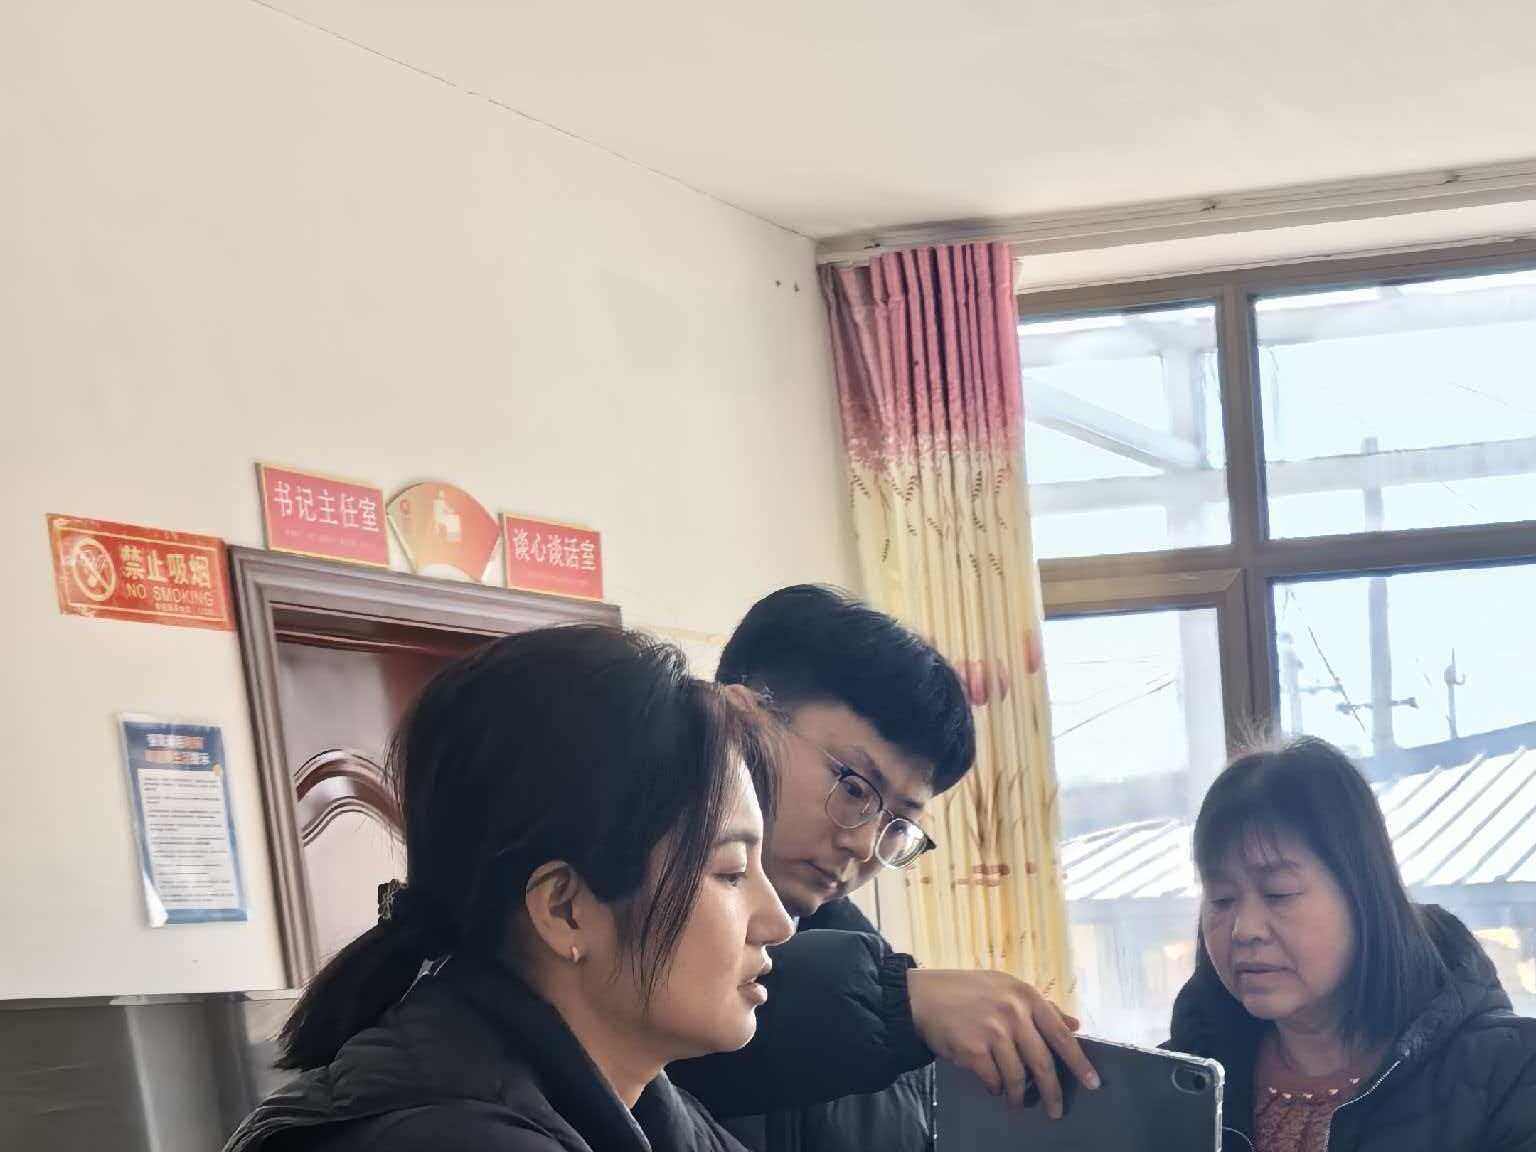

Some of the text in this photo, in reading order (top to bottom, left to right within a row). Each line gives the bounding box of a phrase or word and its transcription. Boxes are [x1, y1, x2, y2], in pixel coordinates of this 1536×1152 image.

[273, 480, 380, 532] 书记主任室
[119, 543, 212, 589] 禁止吸烟
[512, 527, 596, 571] 谈心谈话室
[126, 582, 214, 607] NO SMOKING
